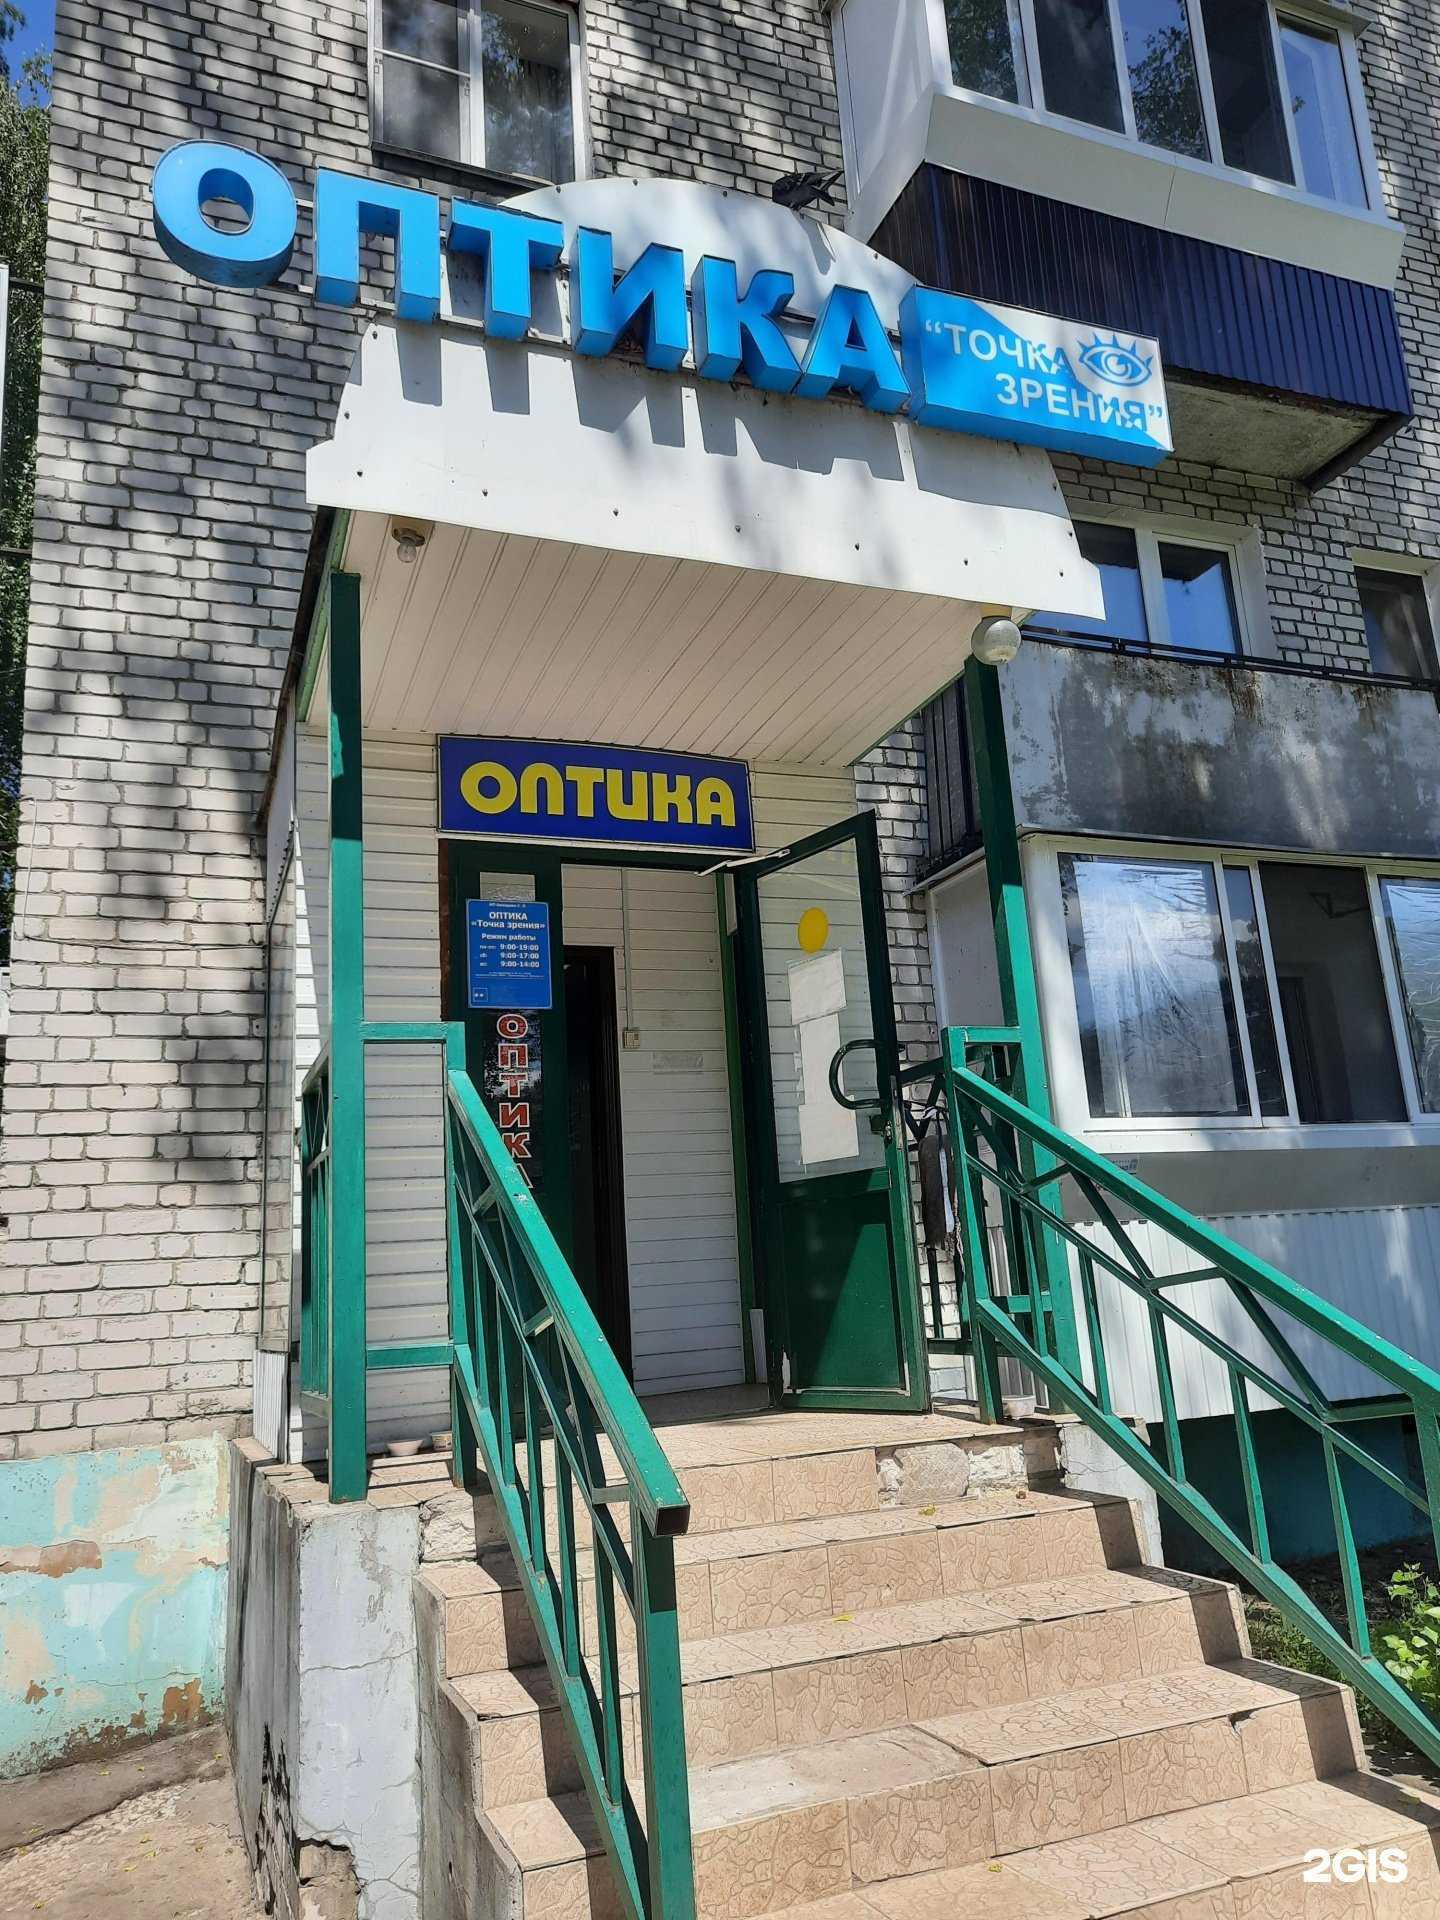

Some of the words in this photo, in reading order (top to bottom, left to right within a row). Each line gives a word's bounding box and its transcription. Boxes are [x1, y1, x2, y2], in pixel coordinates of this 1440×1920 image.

[153, 138, 910, 412] ОПТИКА
[460, 761, 736, 827] ОПТИКА
[489, 911, 528, 921] ОПТИКА
